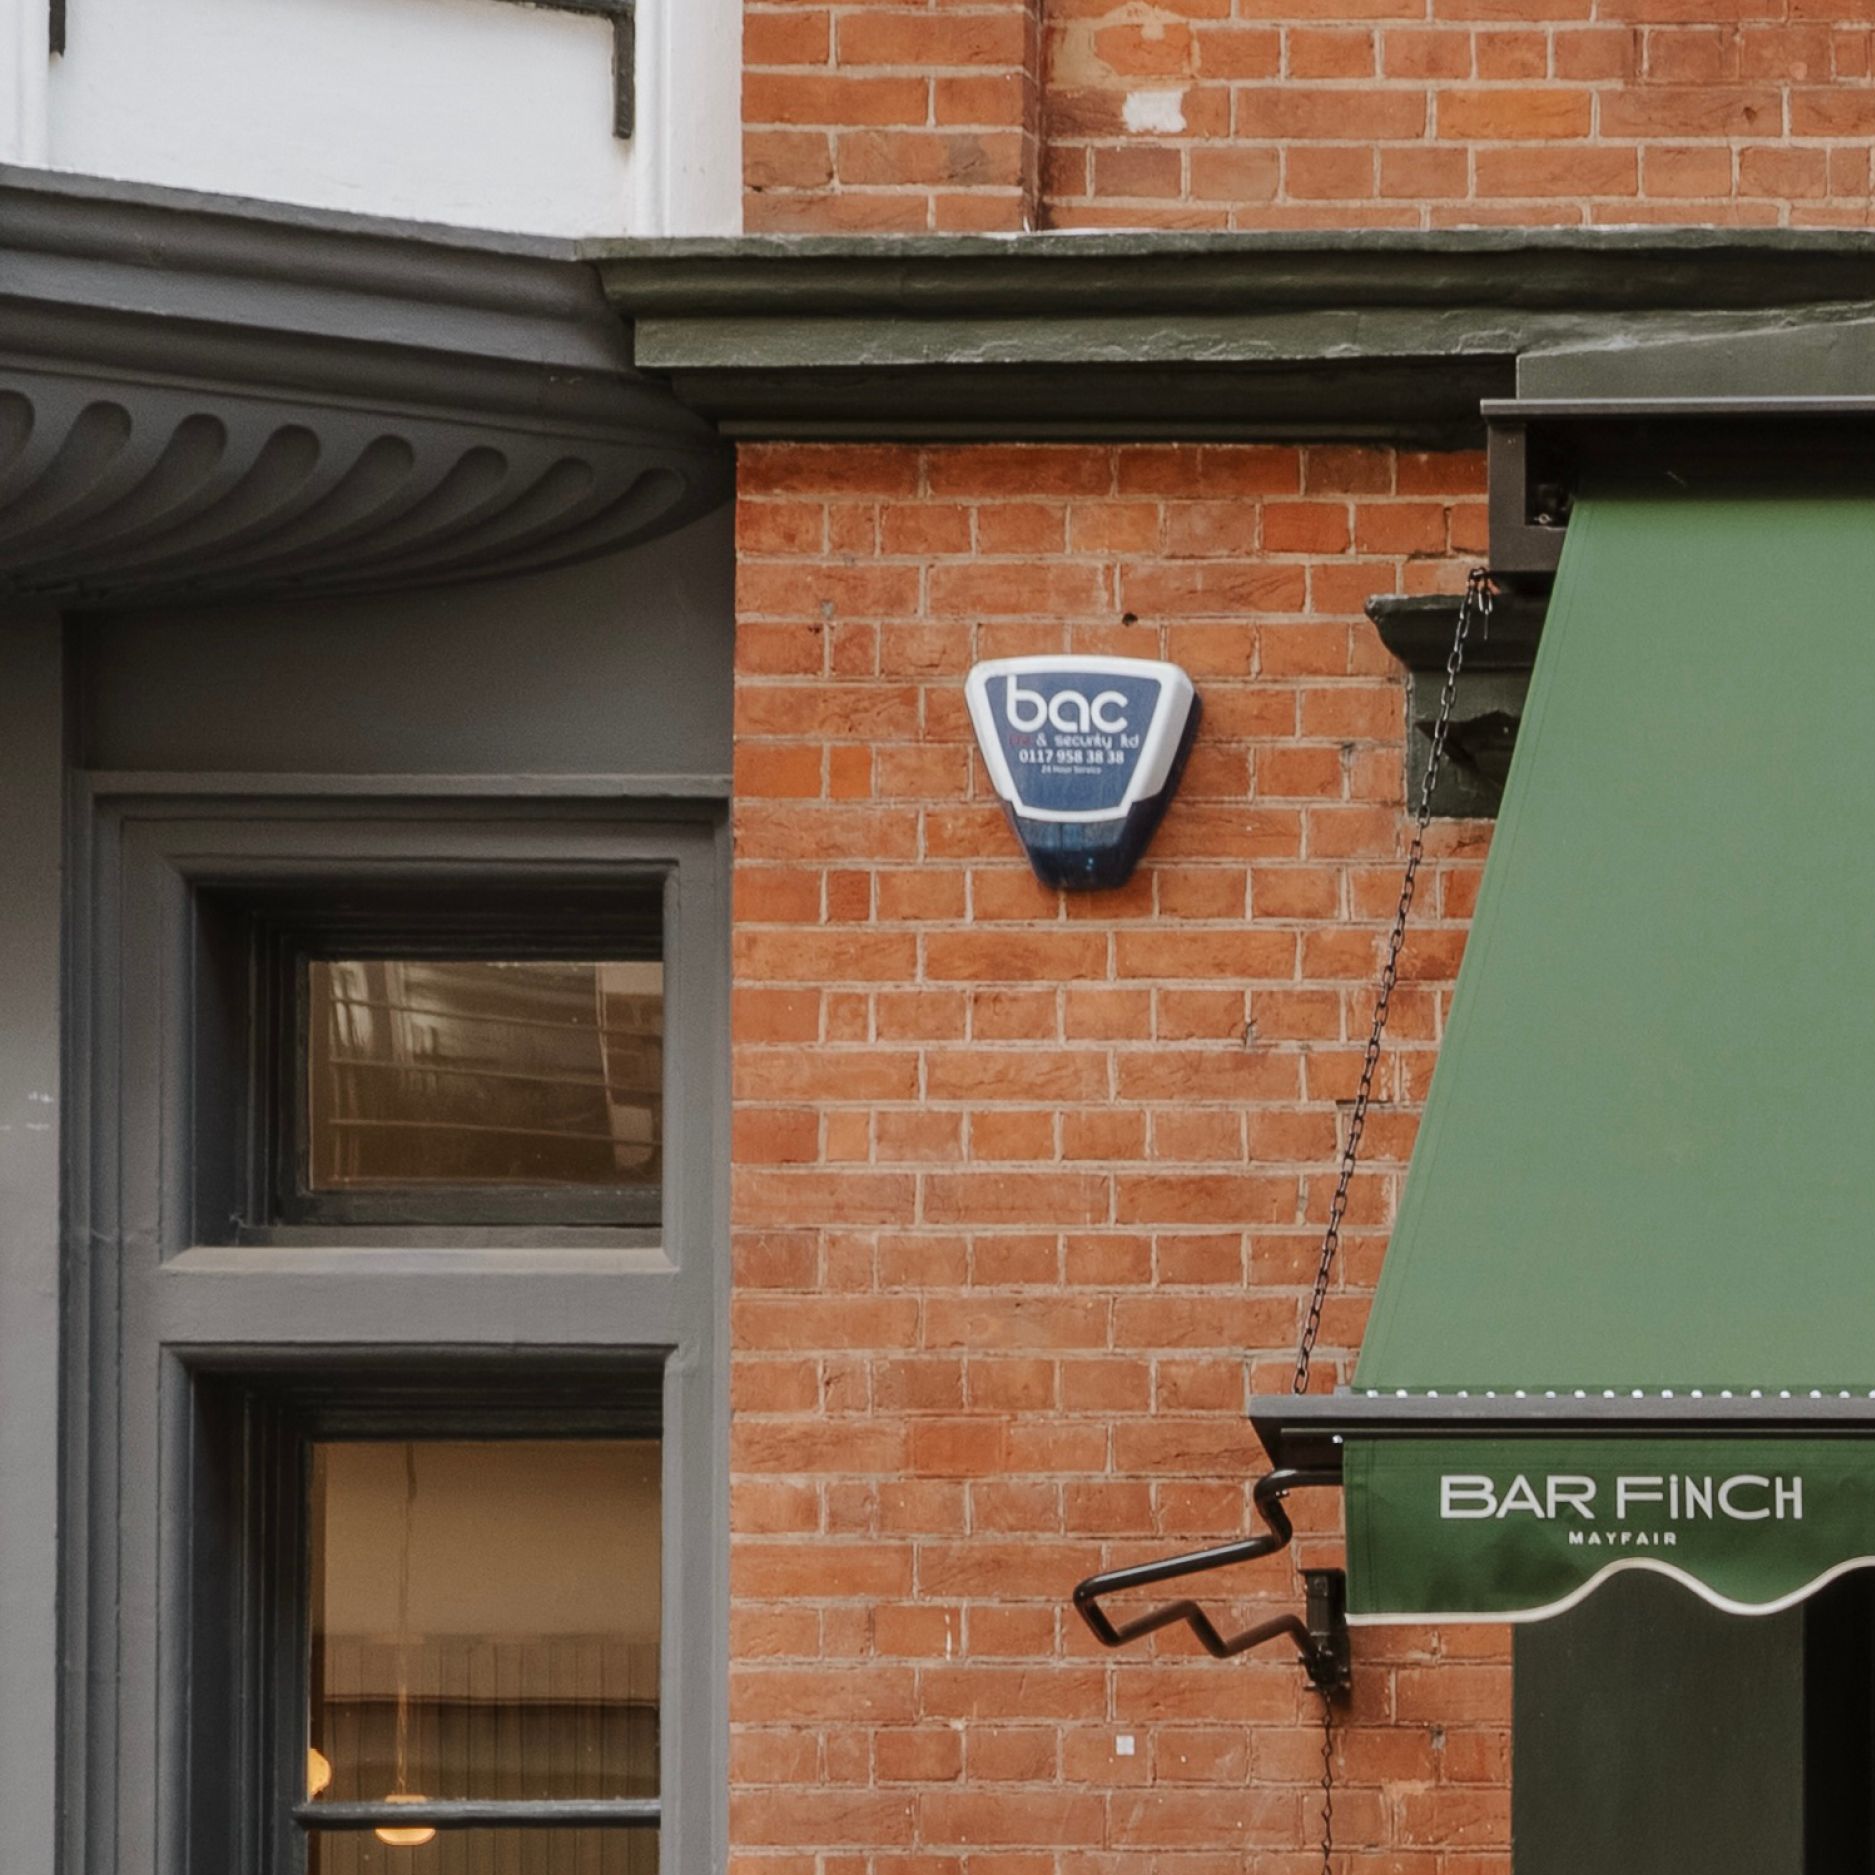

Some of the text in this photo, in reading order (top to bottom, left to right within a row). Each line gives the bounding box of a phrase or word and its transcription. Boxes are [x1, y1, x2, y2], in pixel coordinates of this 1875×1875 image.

[1006, 674, 1128, 733] bac
[1036, 732, 1048, 747] &
[1054, 733, 1113, 750] security
[1120, 733, 1139, 748] ltd
[1018, 748, 1054, 764] 0117
[1439, 1474, 1597, 1519] BAR
[1568, 1531, 1677, 1546] MAYFAIR
